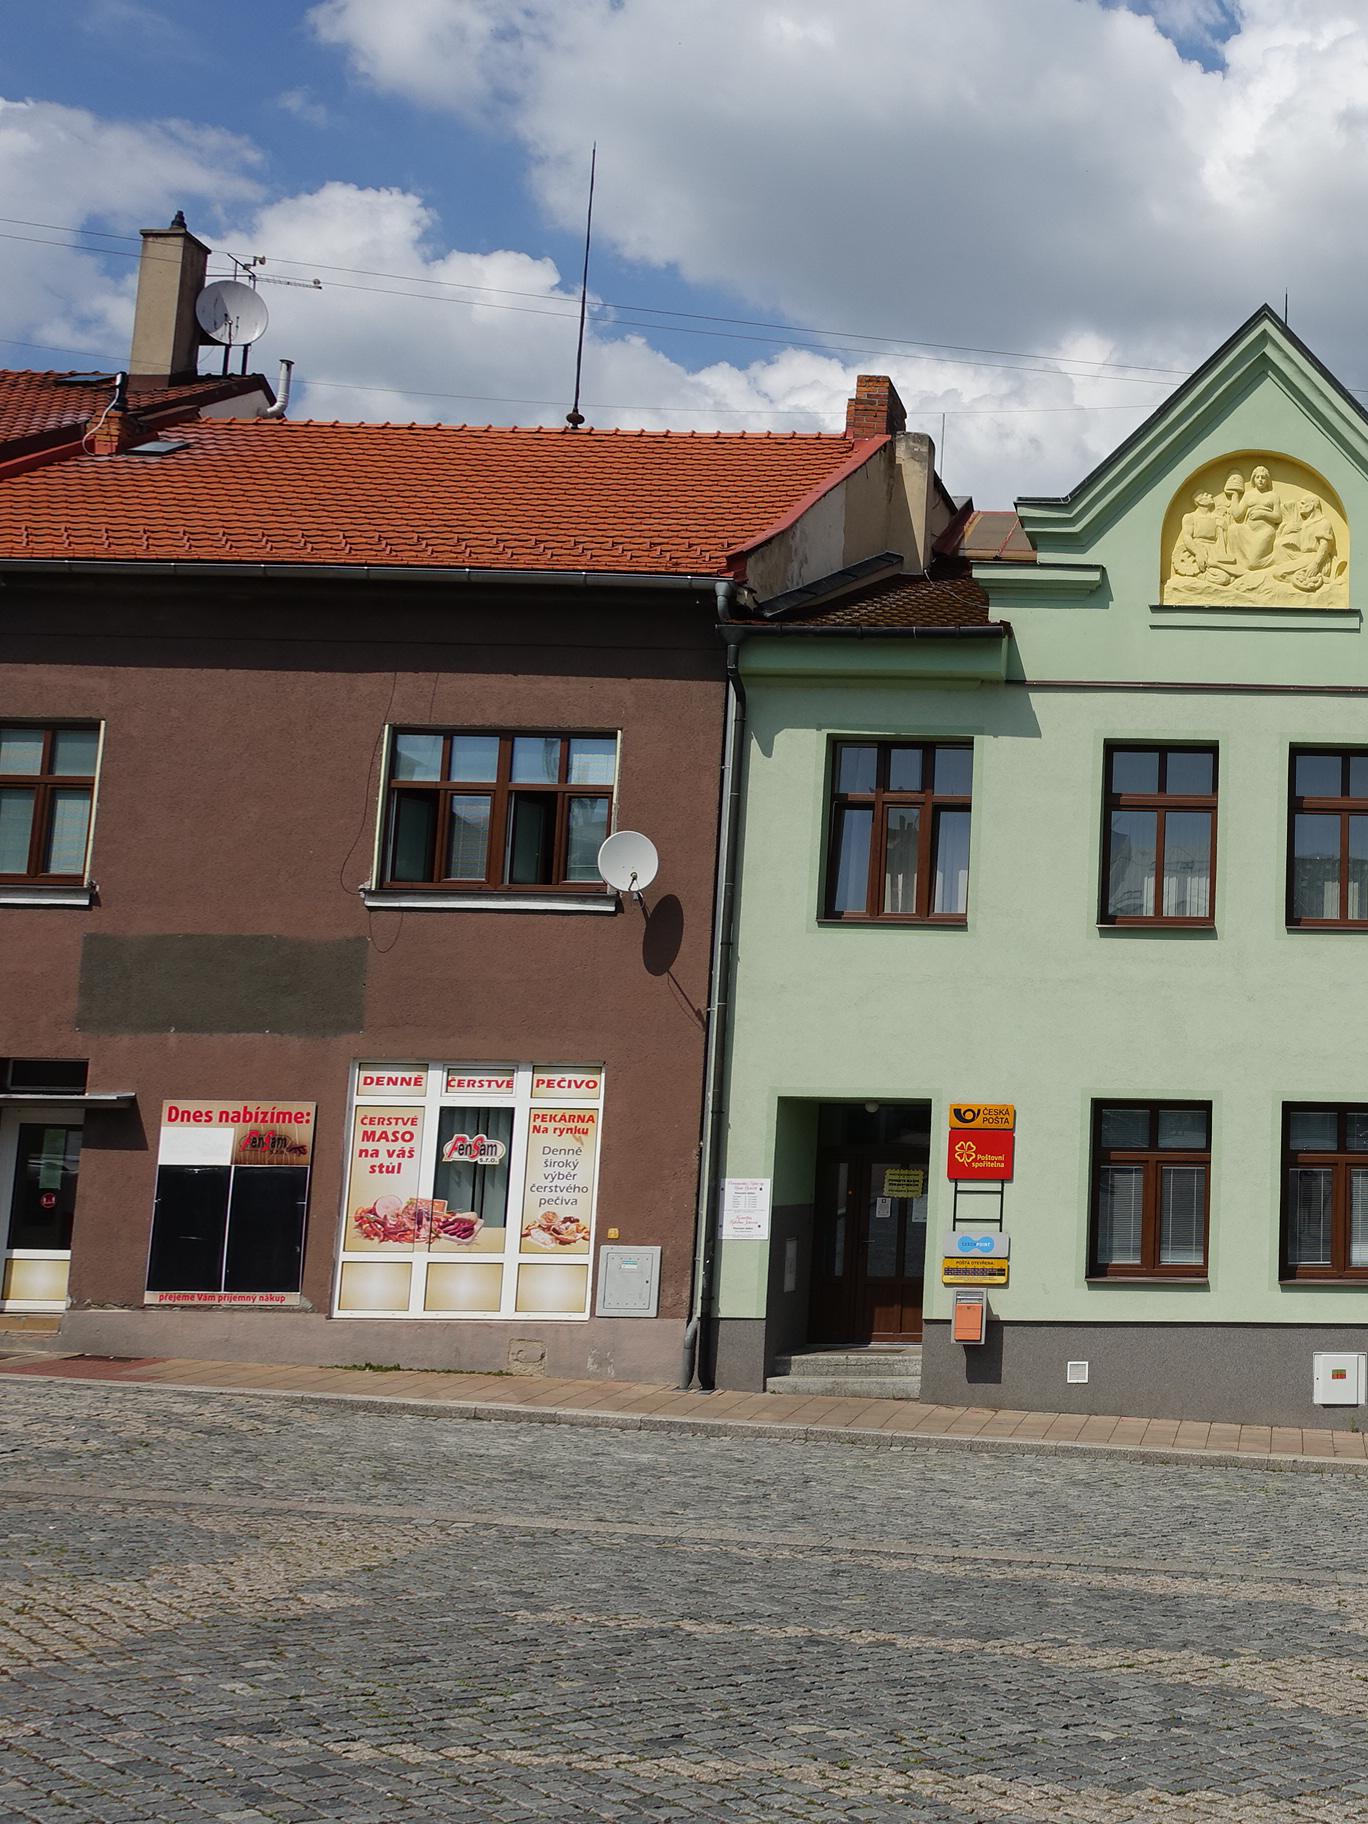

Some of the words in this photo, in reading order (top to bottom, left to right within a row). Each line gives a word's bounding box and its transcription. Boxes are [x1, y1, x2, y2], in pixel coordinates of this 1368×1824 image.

[362, 1074, 424, 1087] DENNĚ
[447, 1076, 514, 1089] ČERSTVÉ
[535, 1077, 598, 1090] PEČIVO
[167, 1105, 213, 1123] Dnes
[218, 1106, 311, 1124] nabízíme:
[982, 1107, 1010, 1116] ČESKÁ
[360, 1114, 418, 1126] ČERSTVÉ
[532, 1112, 595, 1124] PEKÁRNA
[982, 1116, 1010, 1125] POŠTA
[361, 1130, 415, 1143] MASO
[532, 1125, 549, 1134] Na
[553, 1126, 589, 1137] rynku
[358, 1148, 380, 1158] na
[386, 1146, 415, 1158] váš
[447, 1136, 498, 1159] FenSam
[542, 1146, 583, 1156] Denně
[368, 1162, 402, 1174] stůl
[543, 1158, 580, 1171] široký
[971, 1160, 1005, 1169] spořitelna
[543, 1171, 578, 1183] výběr
[529, 1184, 589, 1194] čerstvého
[538, 1196, 578, 1208] pečiva
[158, 1293, 195, 1302] přejeme
[196, 1293, 216, 1301] Vám
[259, 1294, 286, 1303] nákup
